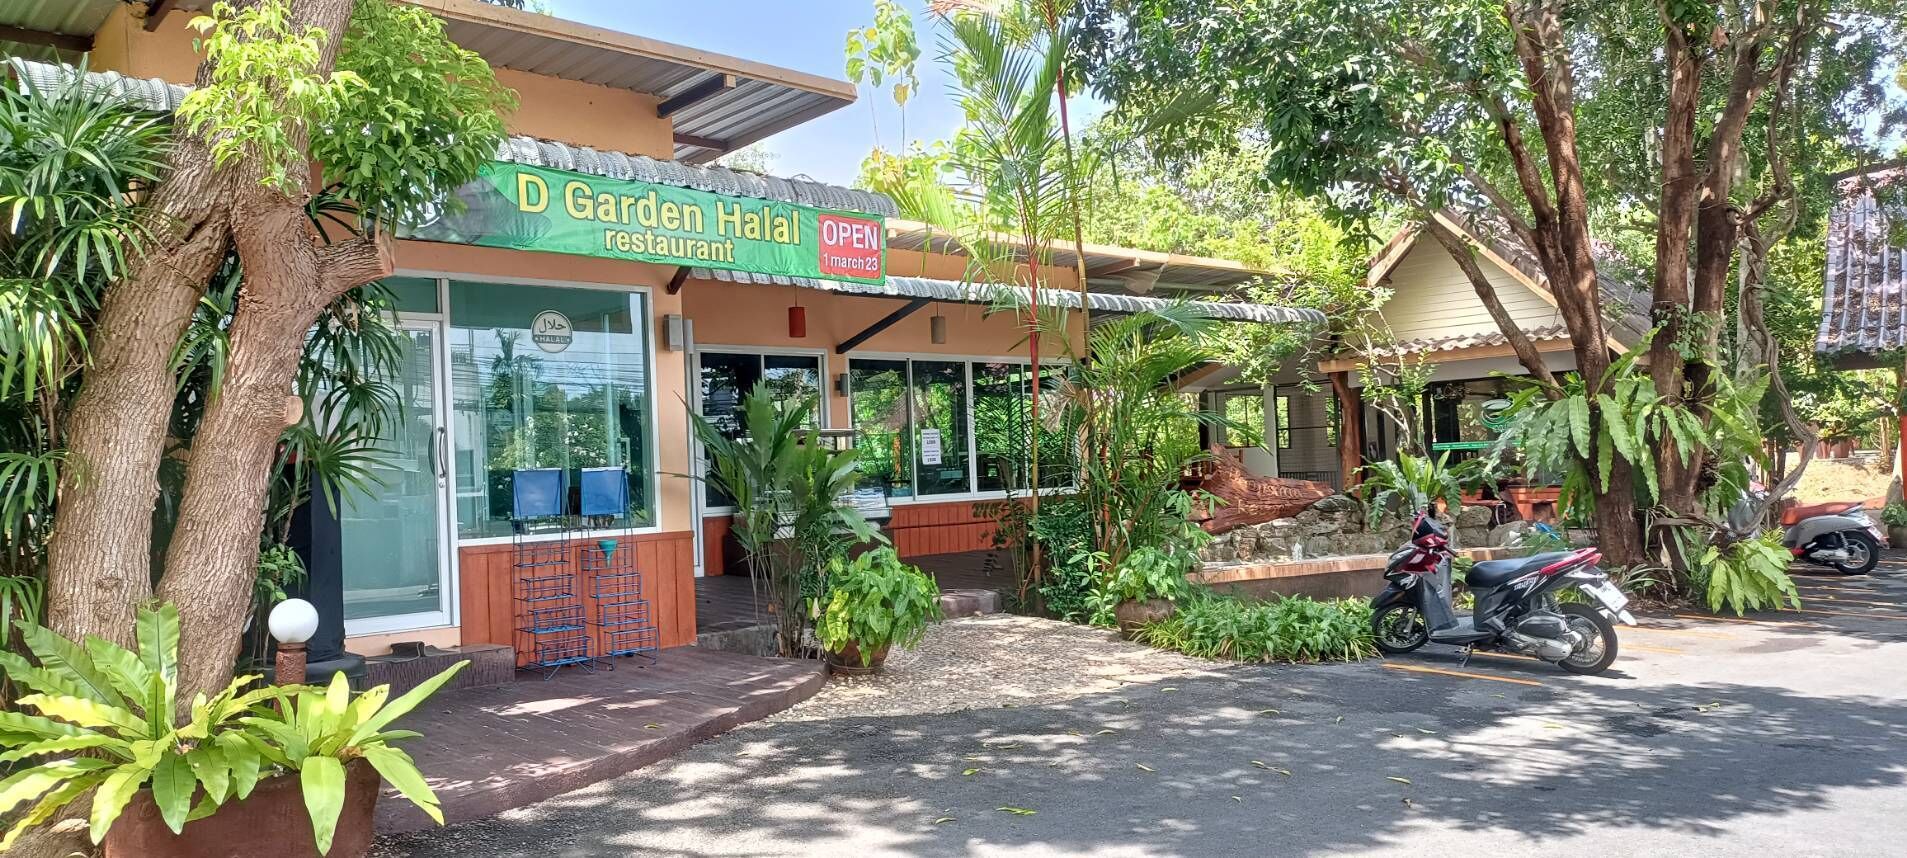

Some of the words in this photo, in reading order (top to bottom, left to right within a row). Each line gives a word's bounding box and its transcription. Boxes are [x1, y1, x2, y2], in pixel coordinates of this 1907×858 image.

[517, 172, 549, 214] D
[564, 180, 704, 234] Garden
[716, 200, 800, 246] Halal
[604, 228, 735, 263] restaurant
[822, 219, 879, 251] OPEN
[823, 252, 829, 266] 1
[830, 255, 864, 270] march
[865, 256, 878, 271] 23
[538, 318, 567, 333] حلال
[540, 335, 565, 343] HALAL
